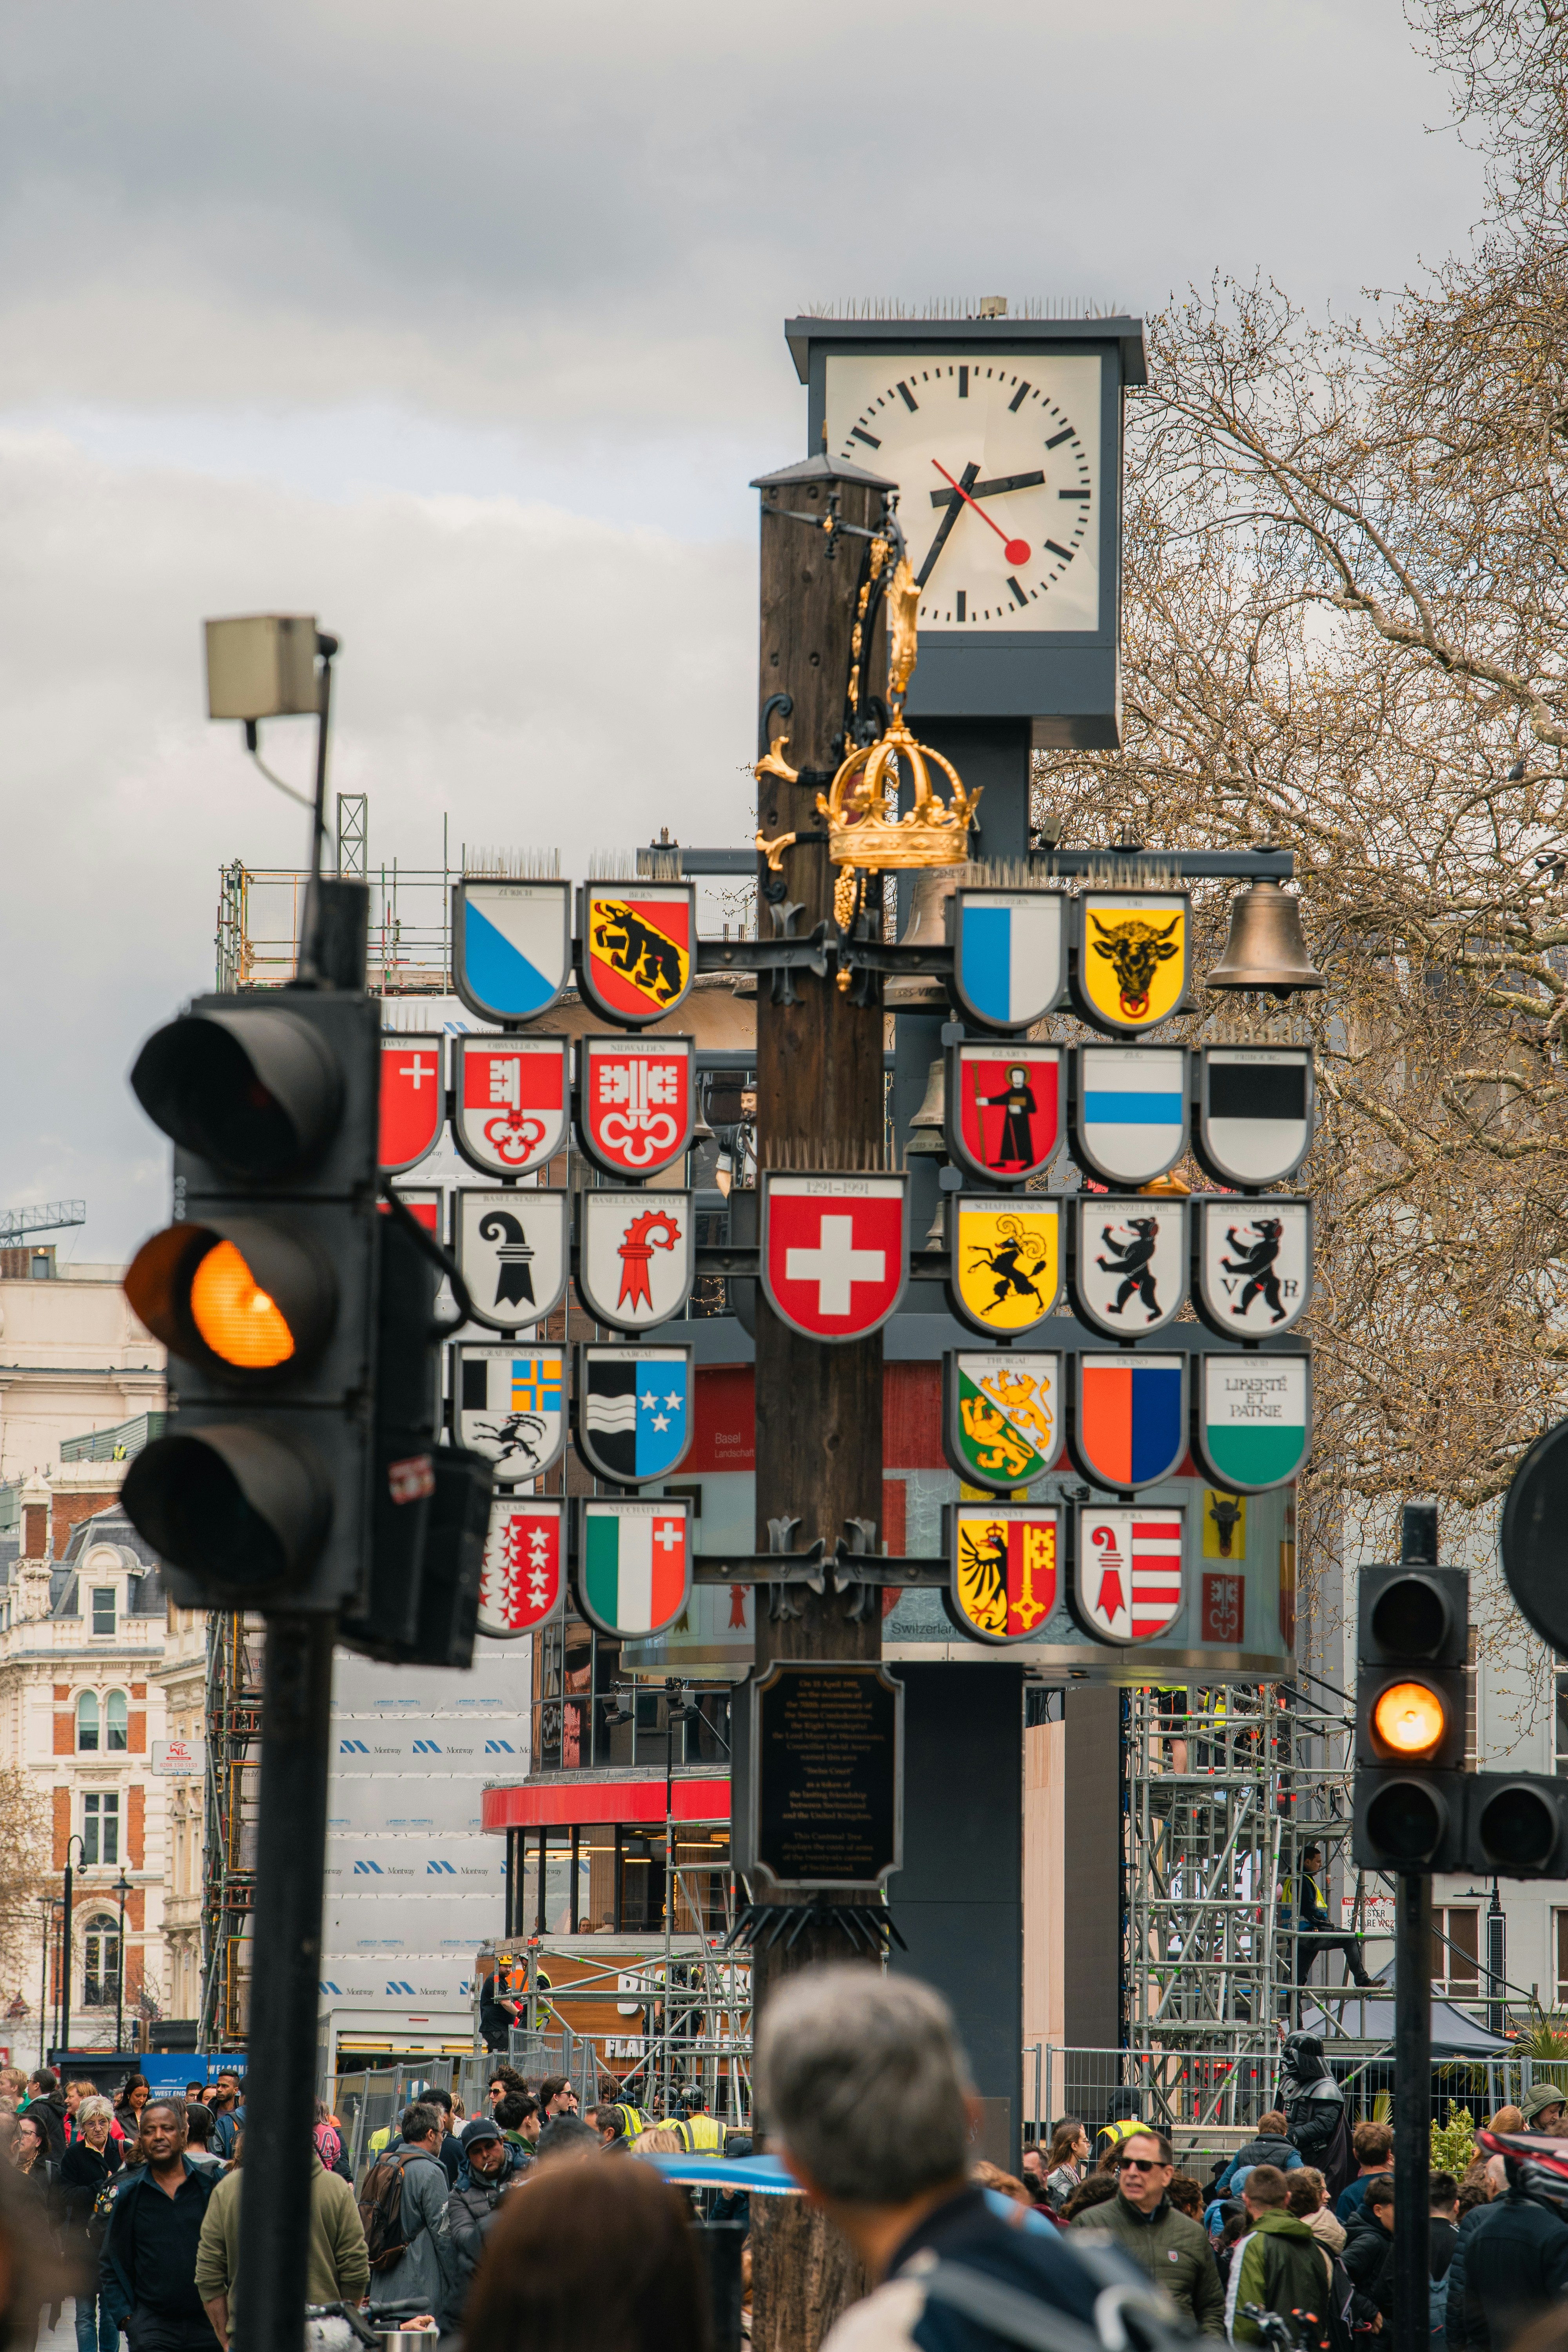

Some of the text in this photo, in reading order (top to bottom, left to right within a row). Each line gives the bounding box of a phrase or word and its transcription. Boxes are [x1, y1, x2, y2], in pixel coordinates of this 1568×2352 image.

[1221, 1279, 1299, 1298] V R
[1247, 1393, 1267, 1405] ET
[1231, 1405, 1282, 1418] PATRIE
[715, 1432, 741, 1444] Basel
[892, 1622, 957, 1634] Switzerlan
[374, 1747, 402, 1755] Montway
[446, 1747, 474, 1755] Montway
[388, 1867, 415, 1875] Montway
[461, 1867, 489, 1875] Montway
[347, 1988, 374, 1996] Montway
[420, 1988, 448, 1996] Montway
